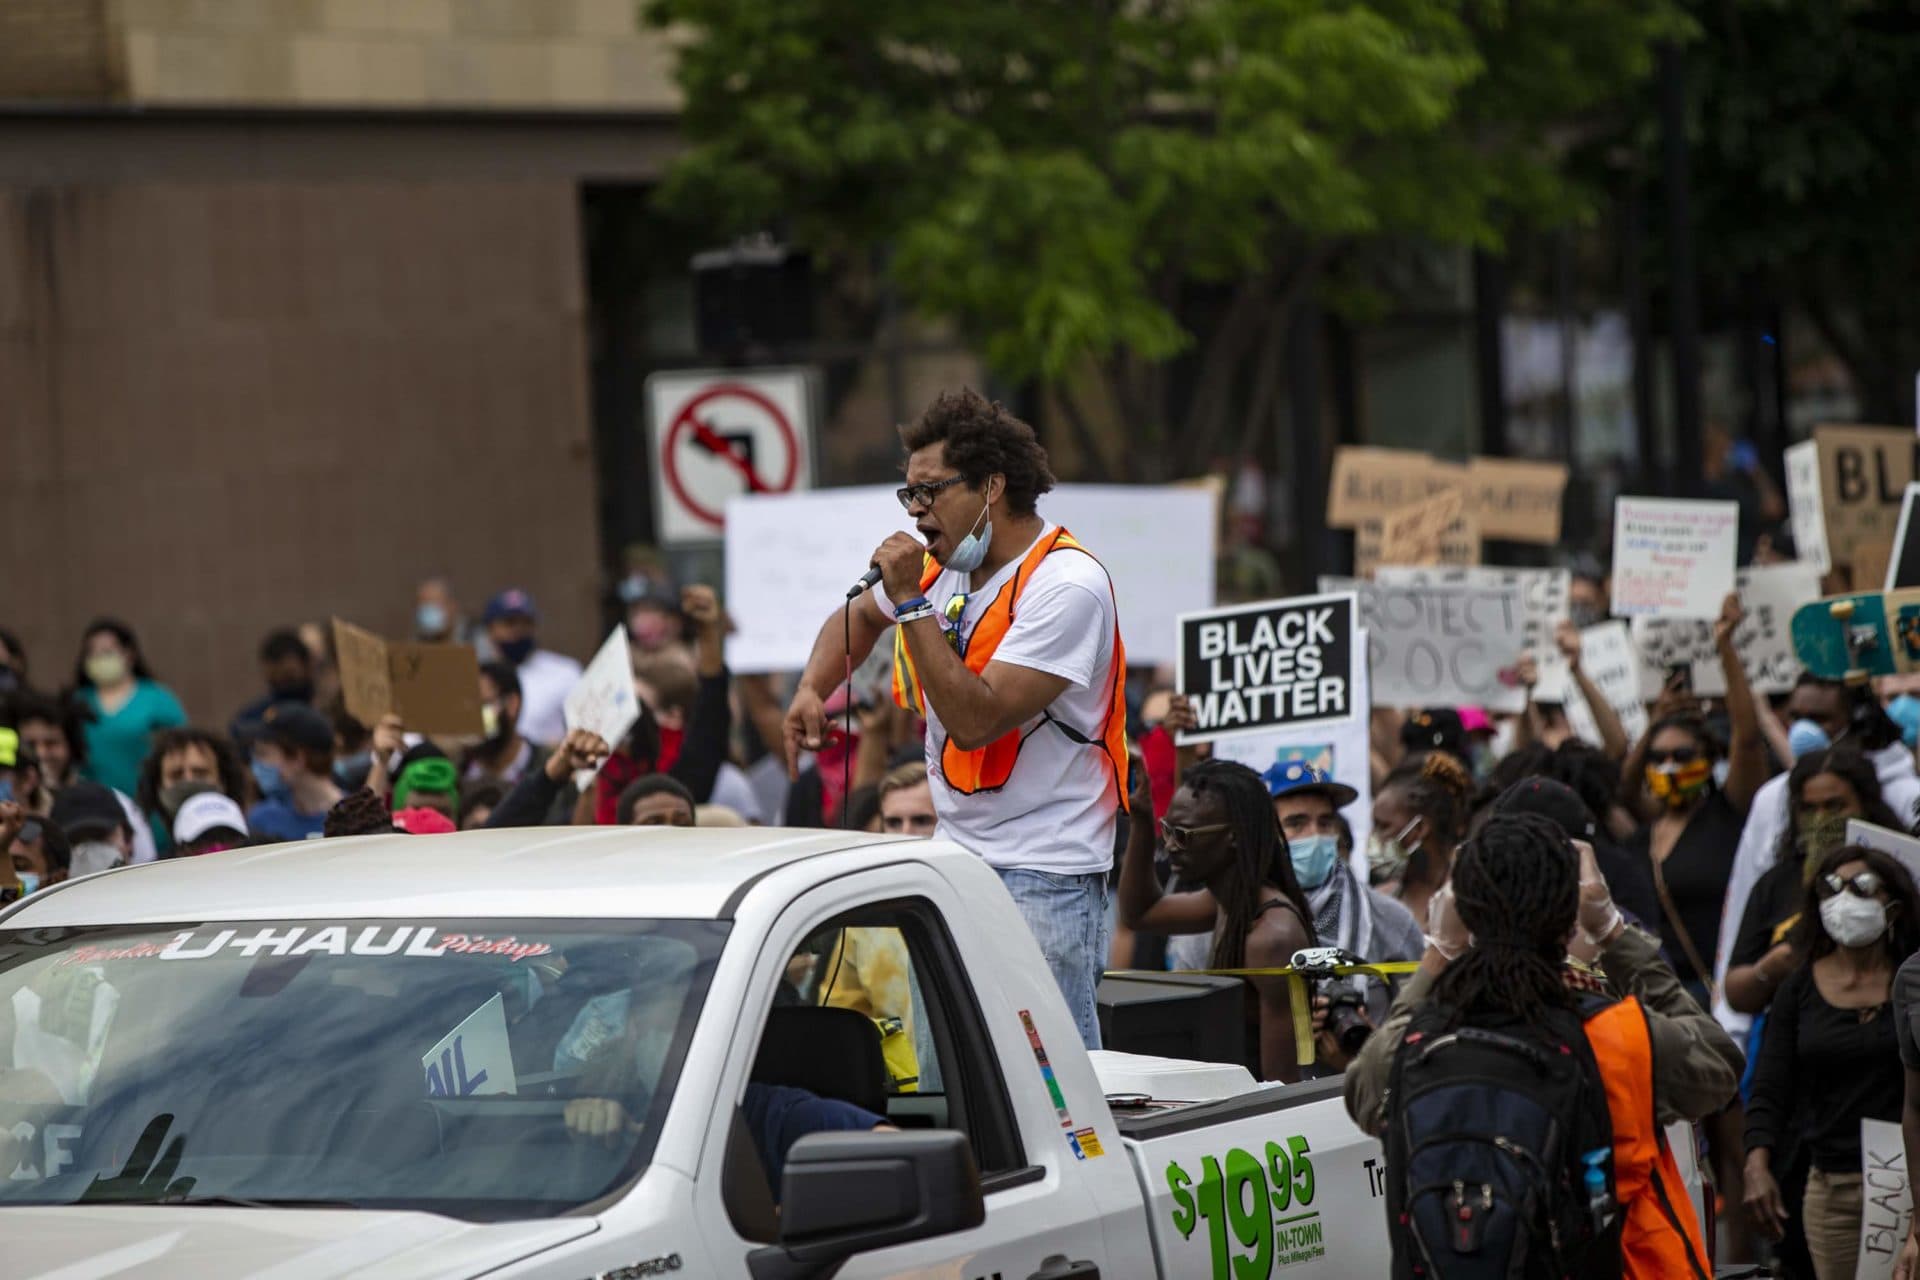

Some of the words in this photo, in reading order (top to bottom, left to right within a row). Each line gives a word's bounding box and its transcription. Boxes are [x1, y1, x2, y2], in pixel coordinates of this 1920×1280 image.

[1836, 440, 1920, 504] BL
[1199, 608, 1334, 660] BLACK
[1210, 645, 1323, 694] LIVES
[1189, 676, 1346, 729] MATTER
[159, 926, 446, 960] U-HAUL
[1363, 1158, 1385, 1198] Tr
[1865, 1151, 1906, 1266] BLACK
[1276, 1222, 1322, 1253] IN-TOWN
